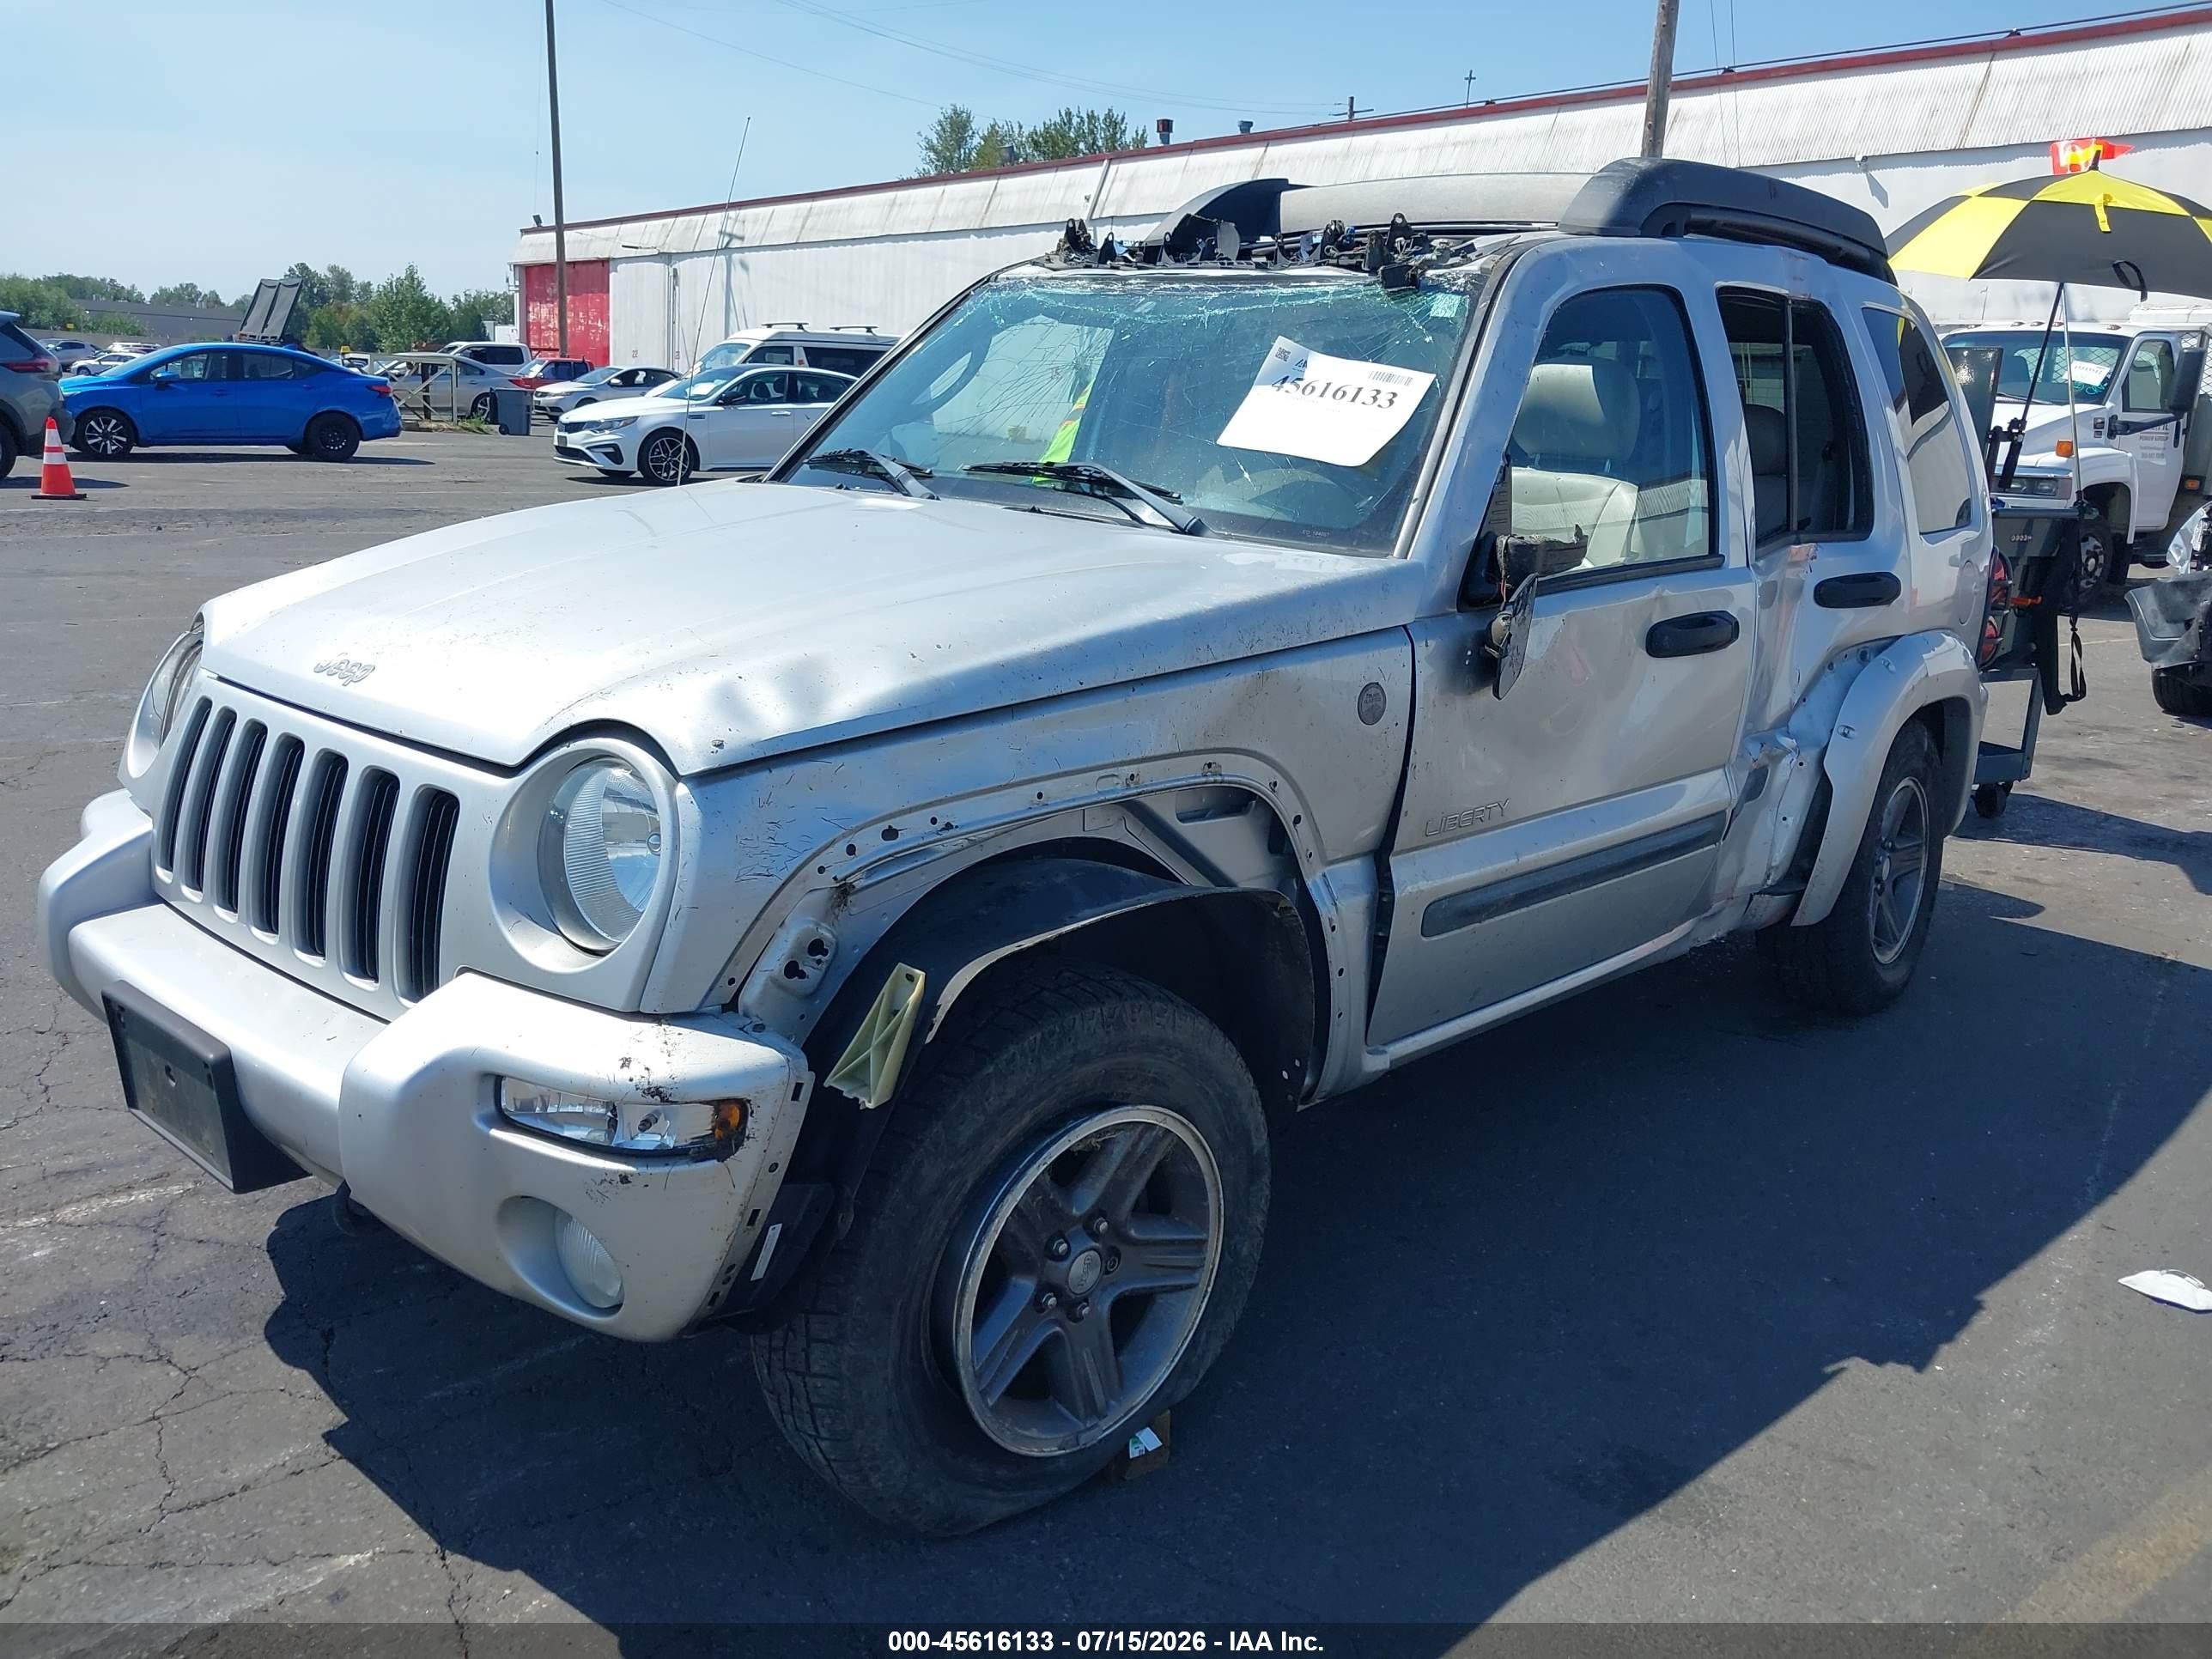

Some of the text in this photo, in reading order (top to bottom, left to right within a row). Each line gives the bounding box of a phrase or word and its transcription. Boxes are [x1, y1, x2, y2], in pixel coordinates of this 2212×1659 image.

[1271, 375, 1399, 410] 45616133
[313, 652, 376, 687] Jeep
[1425, 798, 1510, 837] LIBERTY
